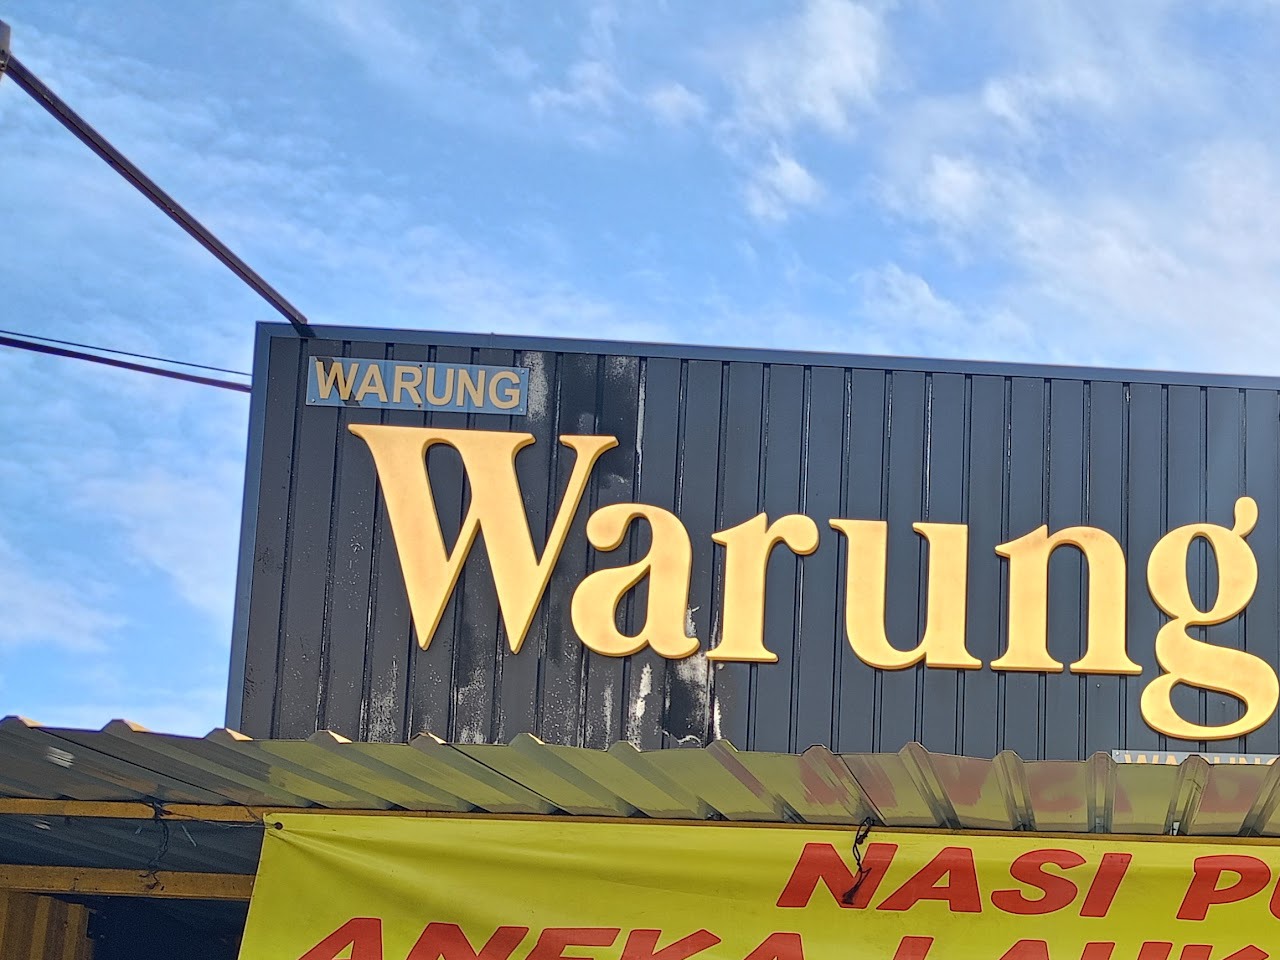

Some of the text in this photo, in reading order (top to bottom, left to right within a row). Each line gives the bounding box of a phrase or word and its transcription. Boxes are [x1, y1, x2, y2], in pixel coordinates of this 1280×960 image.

[315, 361, 521, 409] WARUNG
[348, 423, 1280, 741] Warung
[777, 842, 1132, 918] NASI
